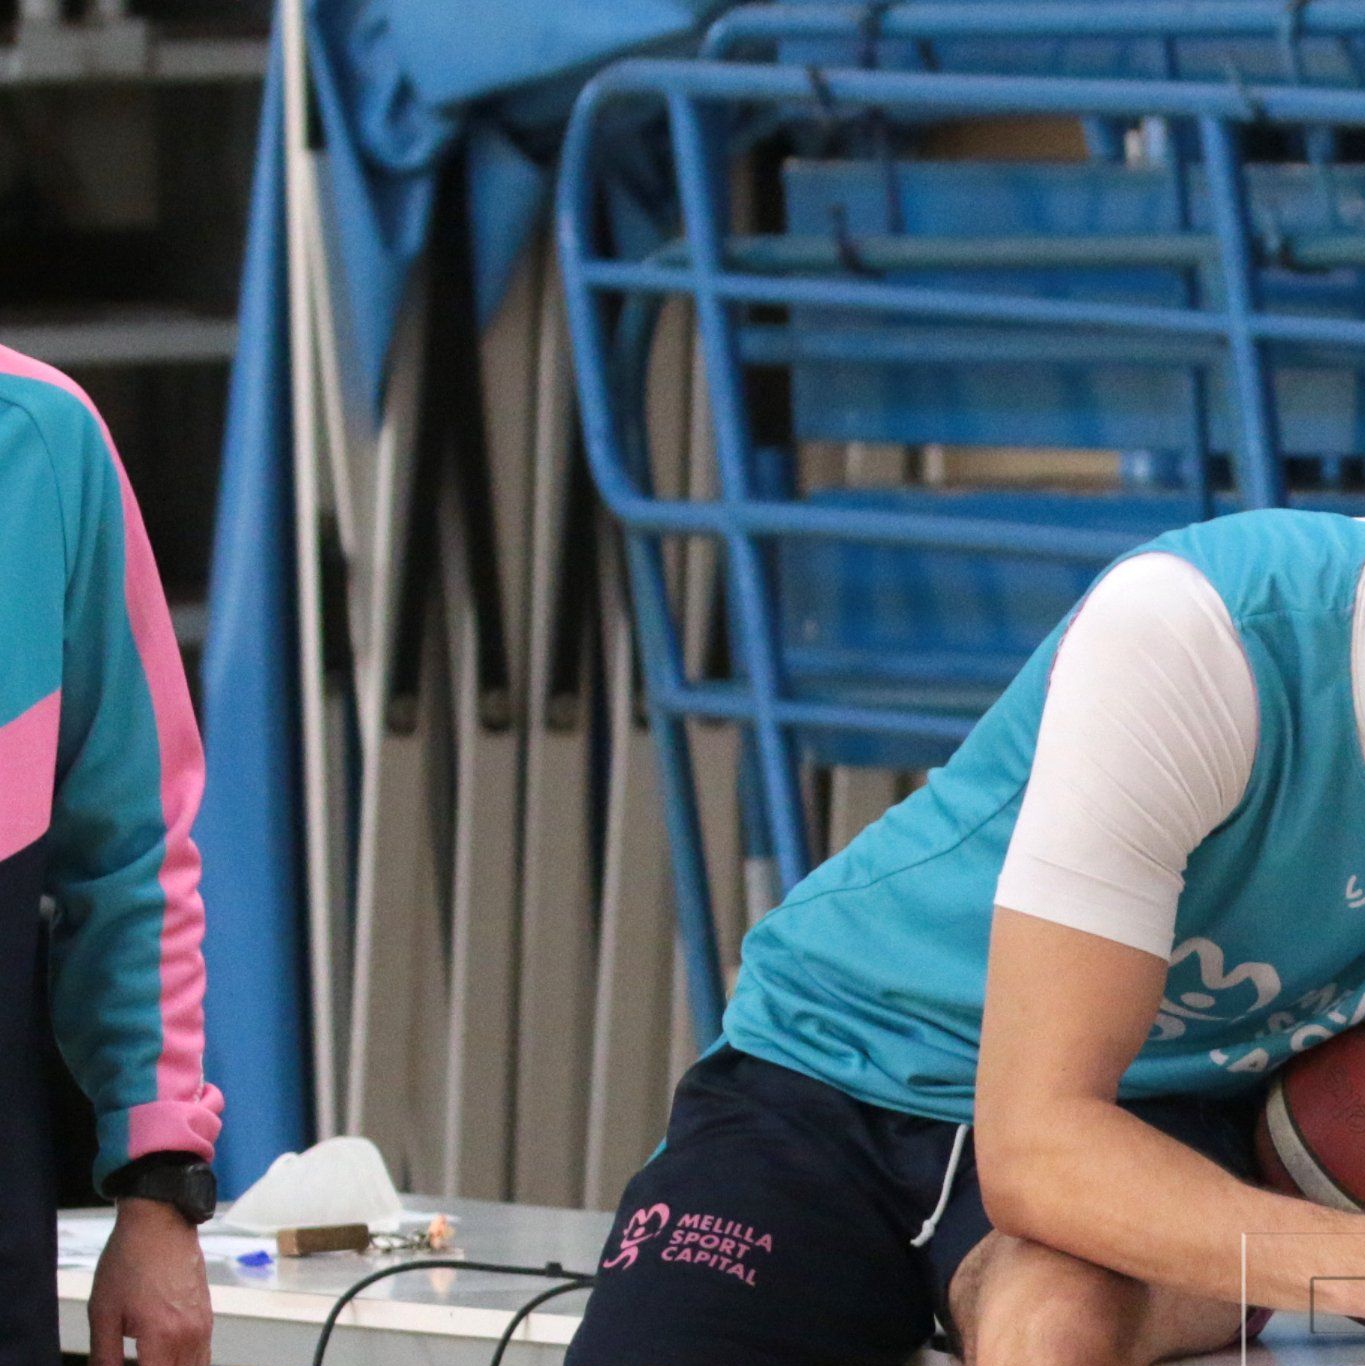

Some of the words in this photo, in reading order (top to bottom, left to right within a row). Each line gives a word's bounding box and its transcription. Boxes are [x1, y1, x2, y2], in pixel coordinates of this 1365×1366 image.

[669, 1229, 750, 1259] SPORT
[677, 1213, 773, 1253] MELILLA
[661, 1247, 756, 1287] CAPITAL
